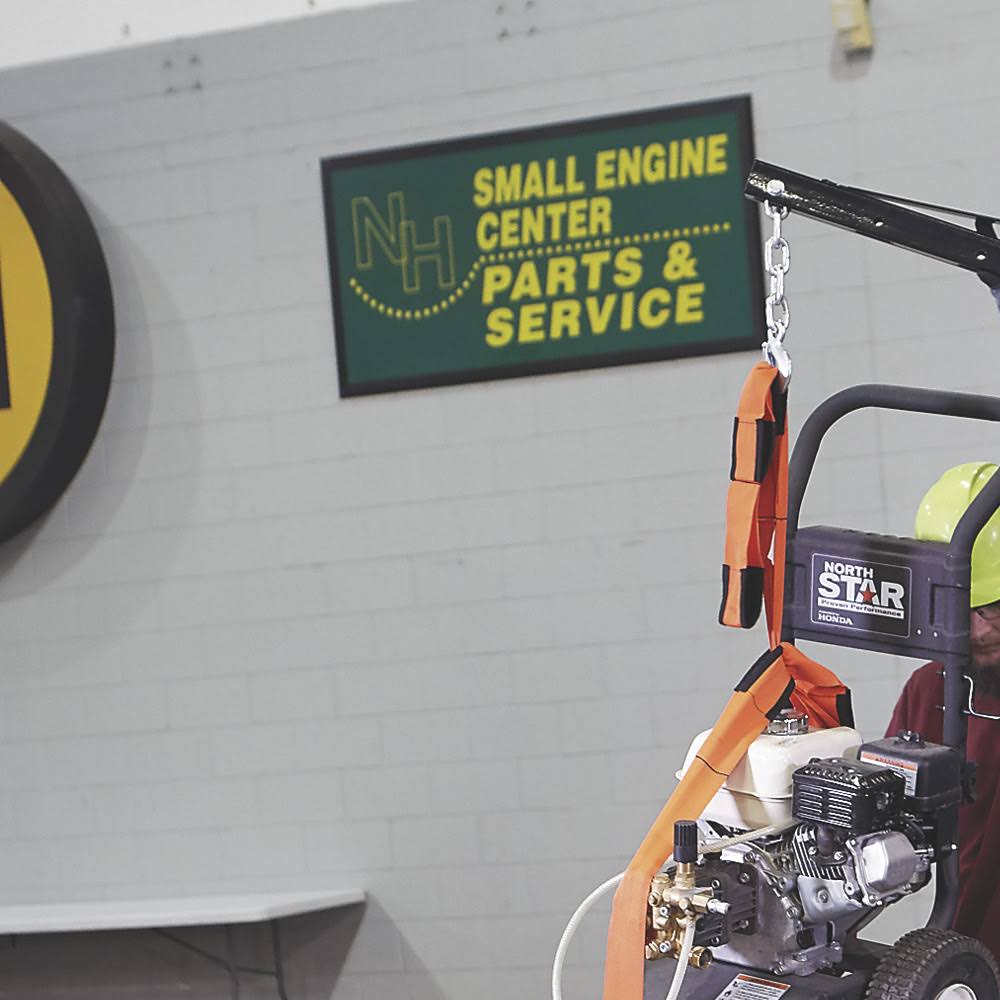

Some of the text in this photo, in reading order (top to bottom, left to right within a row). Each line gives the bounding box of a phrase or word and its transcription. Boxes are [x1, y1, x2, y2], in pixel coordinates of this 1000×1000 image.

[473, 133, 729, 208] SMALL ENGINE
[476, 196, 613, 252] CENTER
[482, 240, 699, 304] PARTS &
[485, 282, 705, 348] SERVICE
[818, 572, 905, 610] STAR
[824, 561, 874, 579] NORTH
[818, 613, 854, 626] HONDA
[850, 603, 903, 617] Performance
